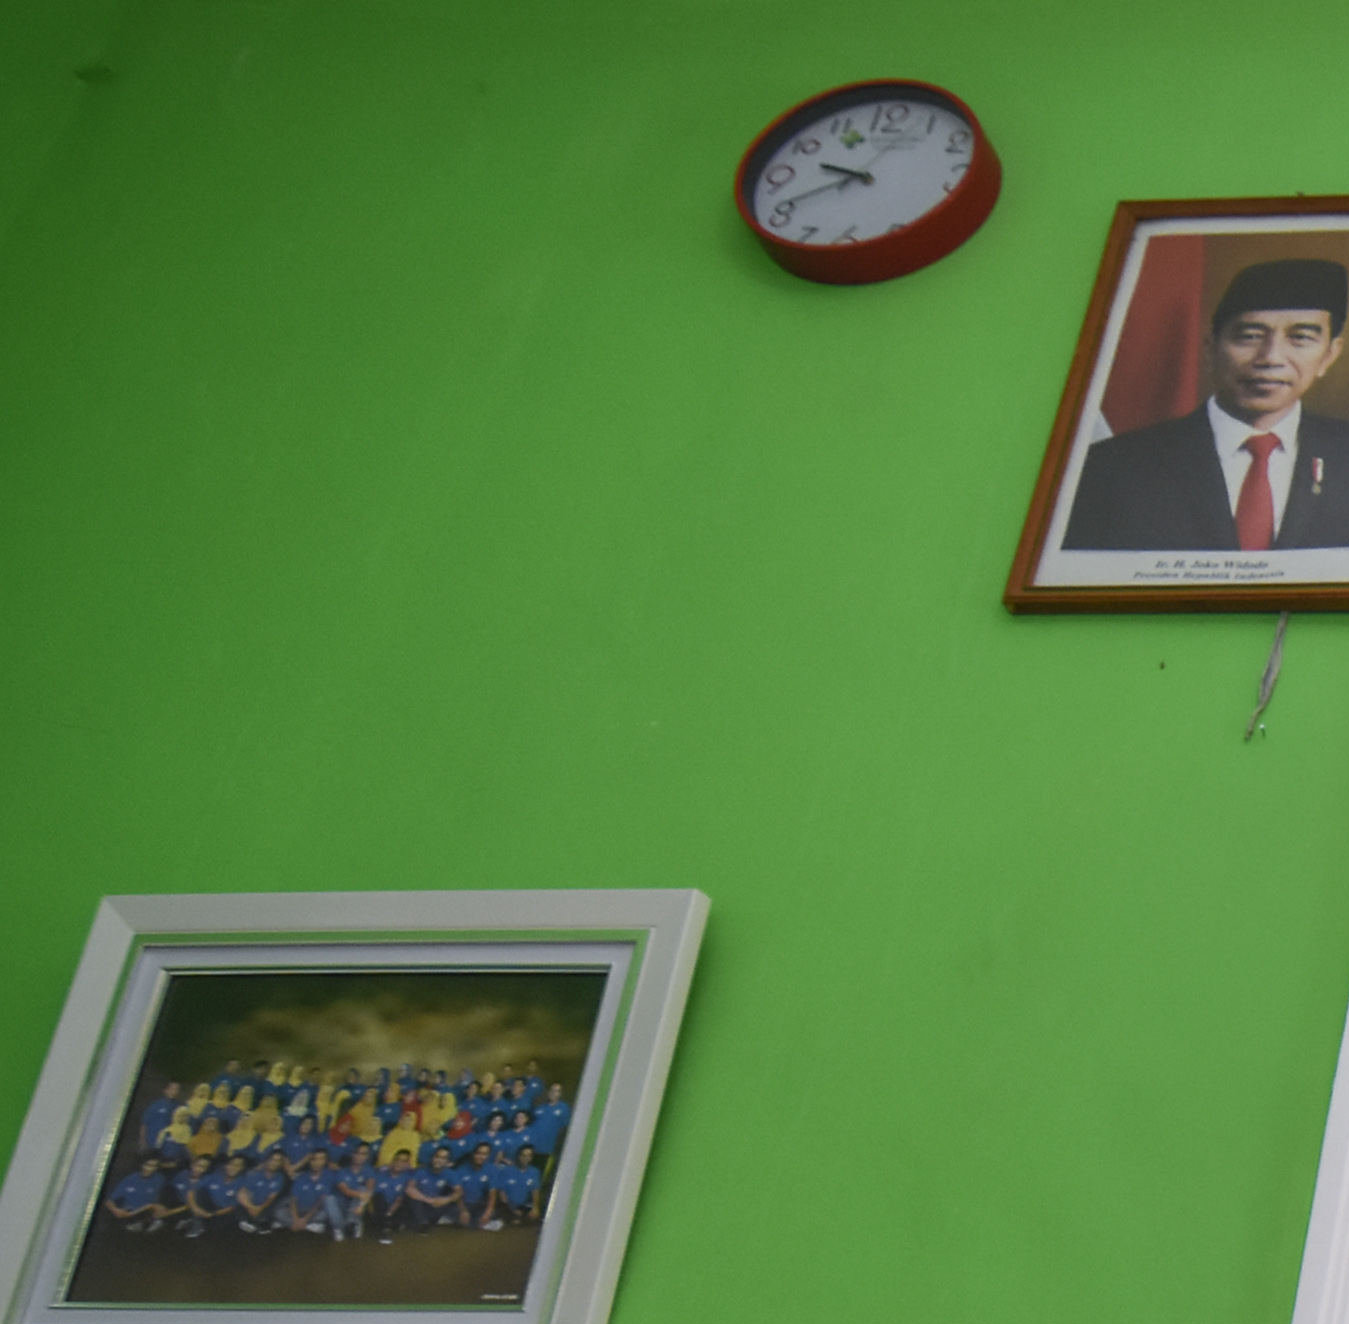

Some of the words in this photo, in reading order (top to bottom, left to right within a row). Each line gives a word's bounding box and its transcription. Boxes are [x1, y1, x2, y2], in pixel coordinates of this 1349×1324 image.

[831, 117, 852, 134] 11
[869, 104, 910, 133] 12
[926, 113, 935, 134] 1
[792, 138, 822, 155] 10
[766, 164, 795, 195] 9
[769, 200, 796, 228] 8
